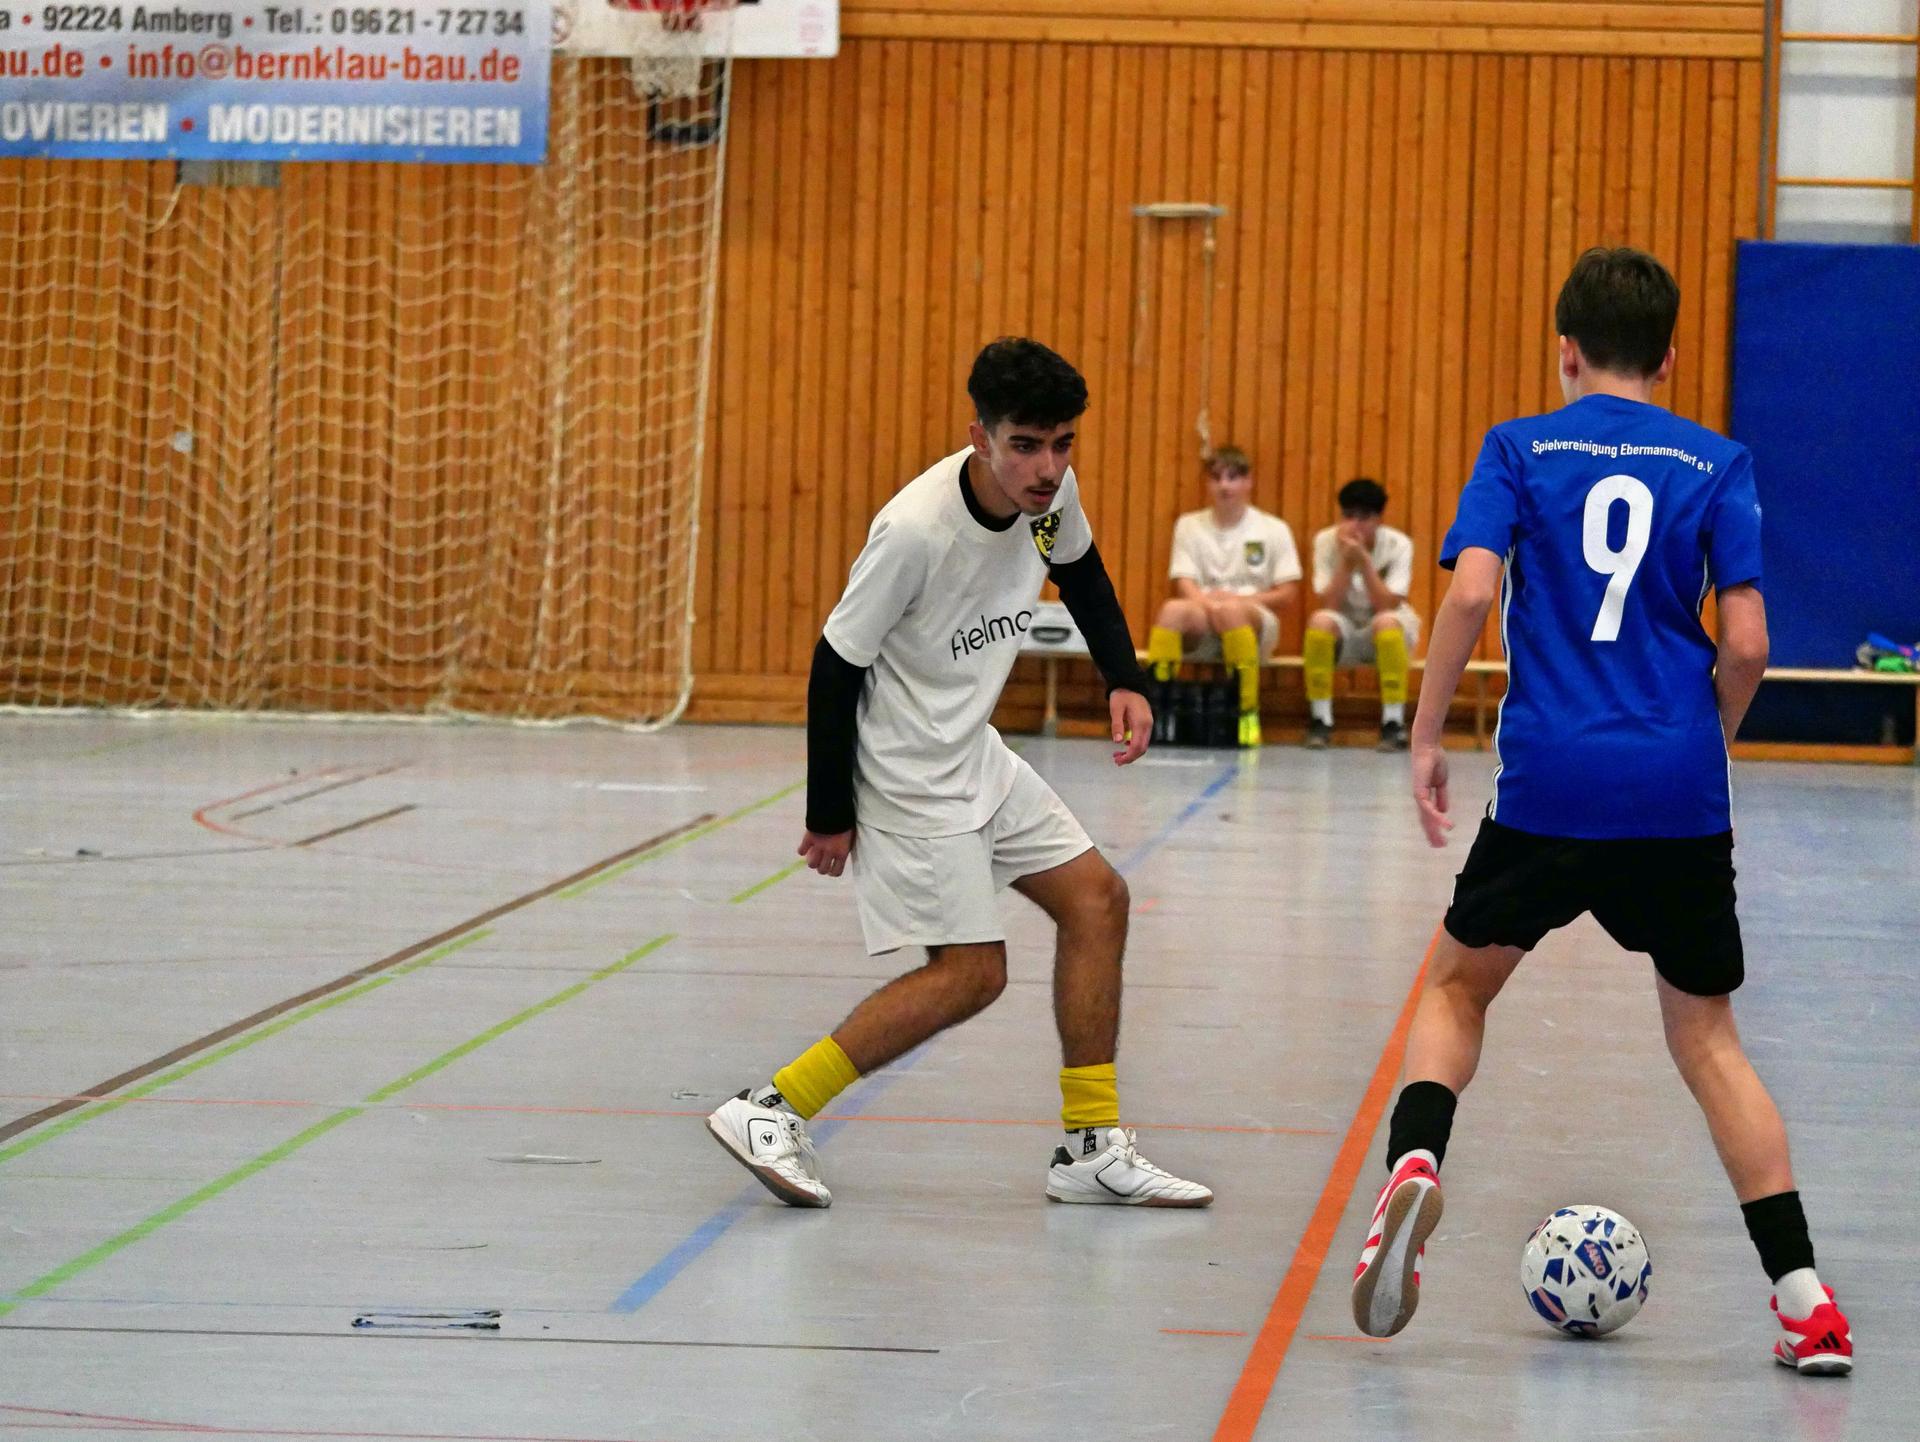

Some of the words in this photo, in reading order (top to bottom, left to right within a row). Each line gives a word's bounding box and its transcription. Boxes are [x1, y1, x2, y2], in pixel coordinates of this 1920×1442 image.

[43, 5, 122, 32] 92224
[132, 6, 232, 38] Amberg
[265, 8, 322, 34] Tel.:
[128, 43, 520, 82] info@bernklau-bau.de
[2, 102, 168, 143] OVIEREN
[208, 104, 521, 146] MODERNISIEREN
[1532, 439, 1618, 458] Spielvereinigung
[1620, 443, 1697, 467] Ebermannsdorf
[1697, 461, 1714, 475] e.V.
[1582, 474, 1654, 642] 9
